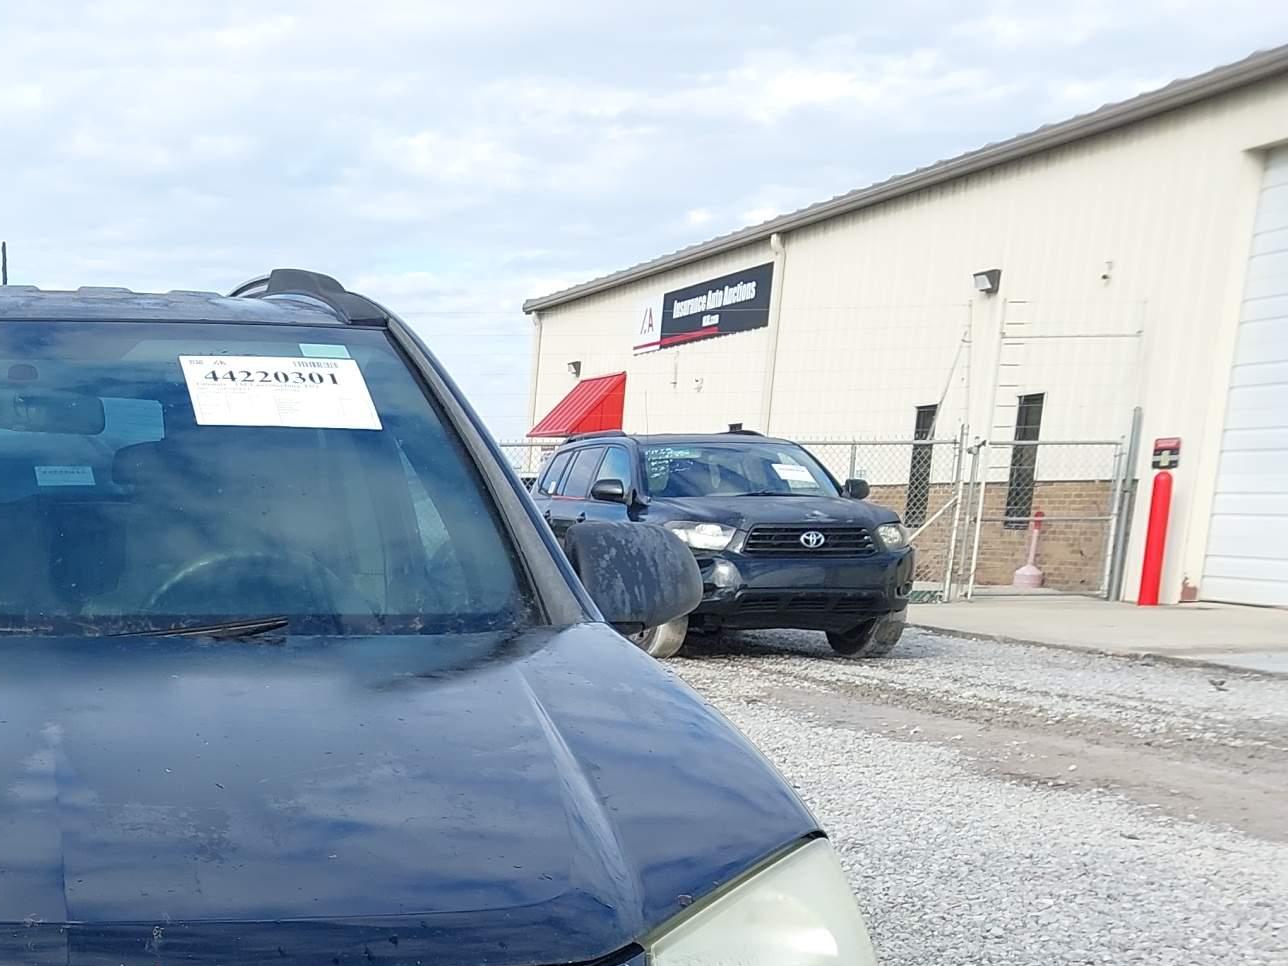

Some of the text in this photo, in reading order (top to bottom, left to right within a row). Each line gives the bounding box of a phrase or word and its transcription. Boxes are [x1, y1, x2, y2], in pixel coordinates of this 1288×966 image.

[672, 280, 757, 319] Insurance Auto Auctions
[204, 369, 340, 385] 44220301
